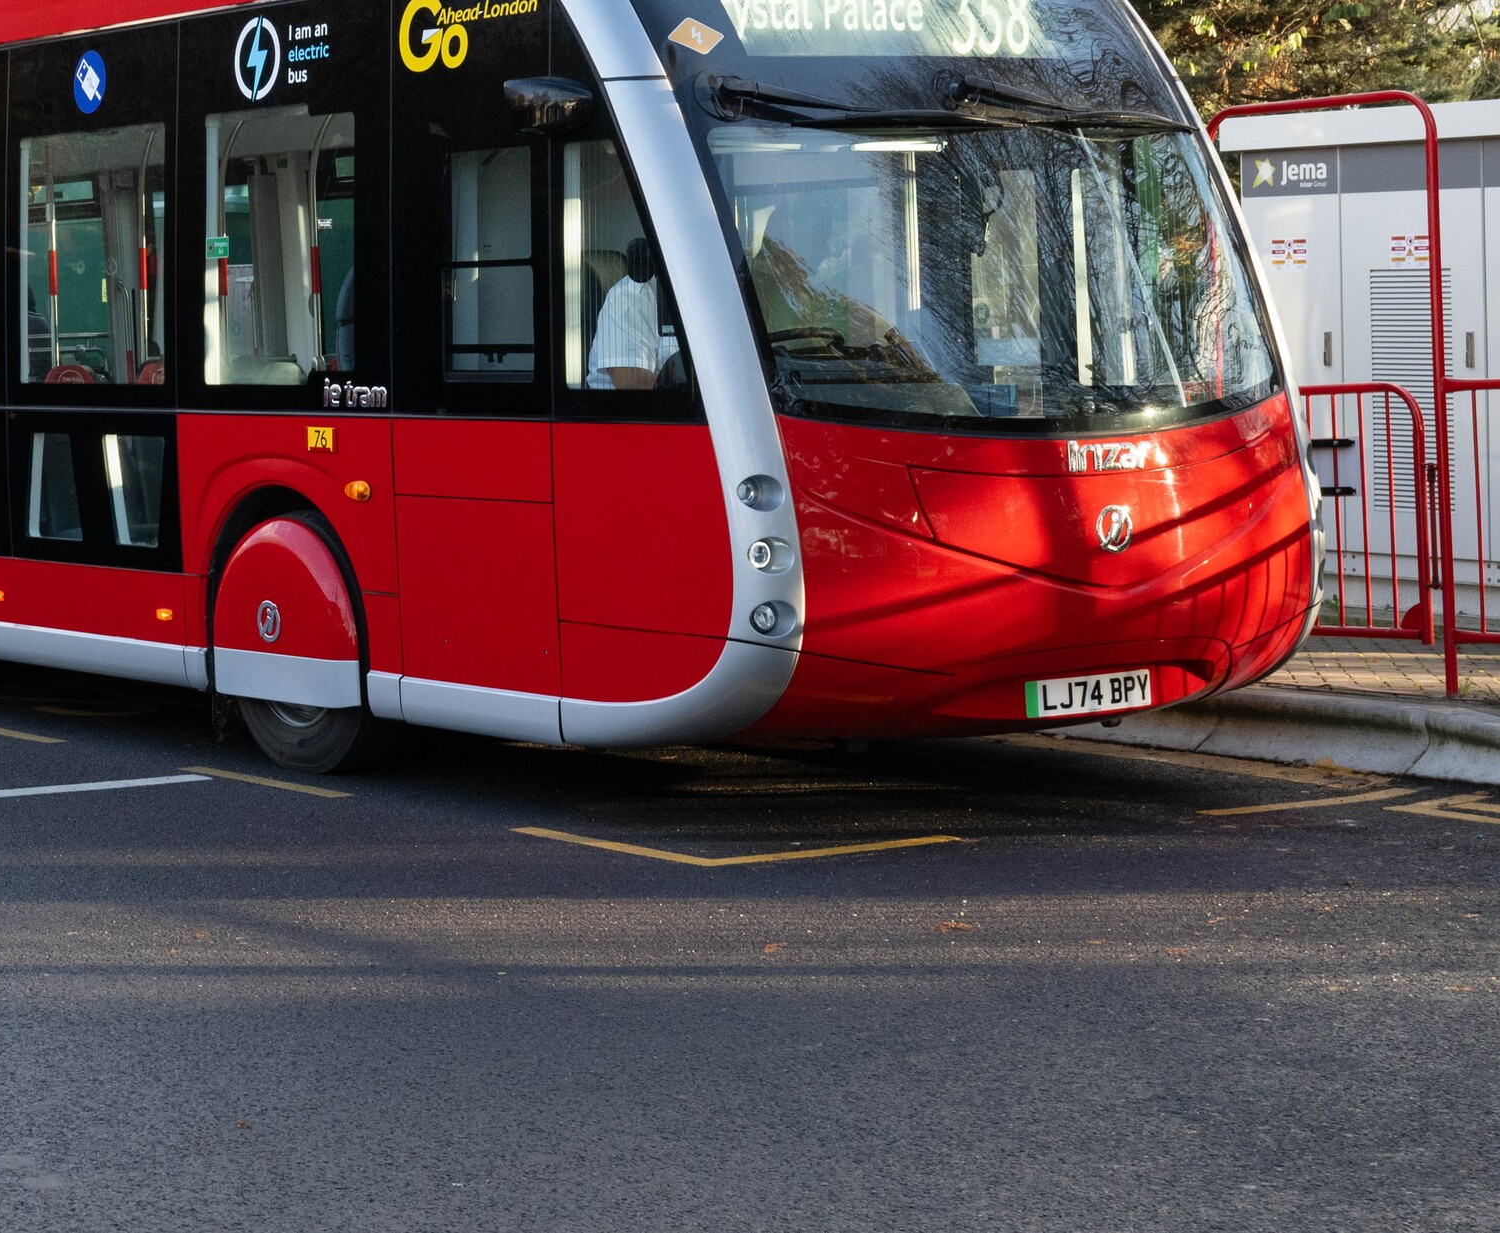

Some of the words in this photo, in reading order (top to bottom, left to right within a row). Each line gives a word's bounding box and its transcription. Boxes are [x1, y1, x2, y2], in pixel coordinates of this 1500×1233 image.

[288, 24, 292, 41] I
[294, 25, 312, 40] am
[314, 23, 328, 37] an
[288, 42, 329, 62] electric
[287, 68, 308, 84] bus
[1280, 160, 1327, 185] Jema
[323, 377, 342, 407] ie
[344, 380, 388, 408] tram
[314, 430, 328, 448] 76
[1042, 679, 1104, 711] LJ74
[1109, 673, 1149, 705] BPY
